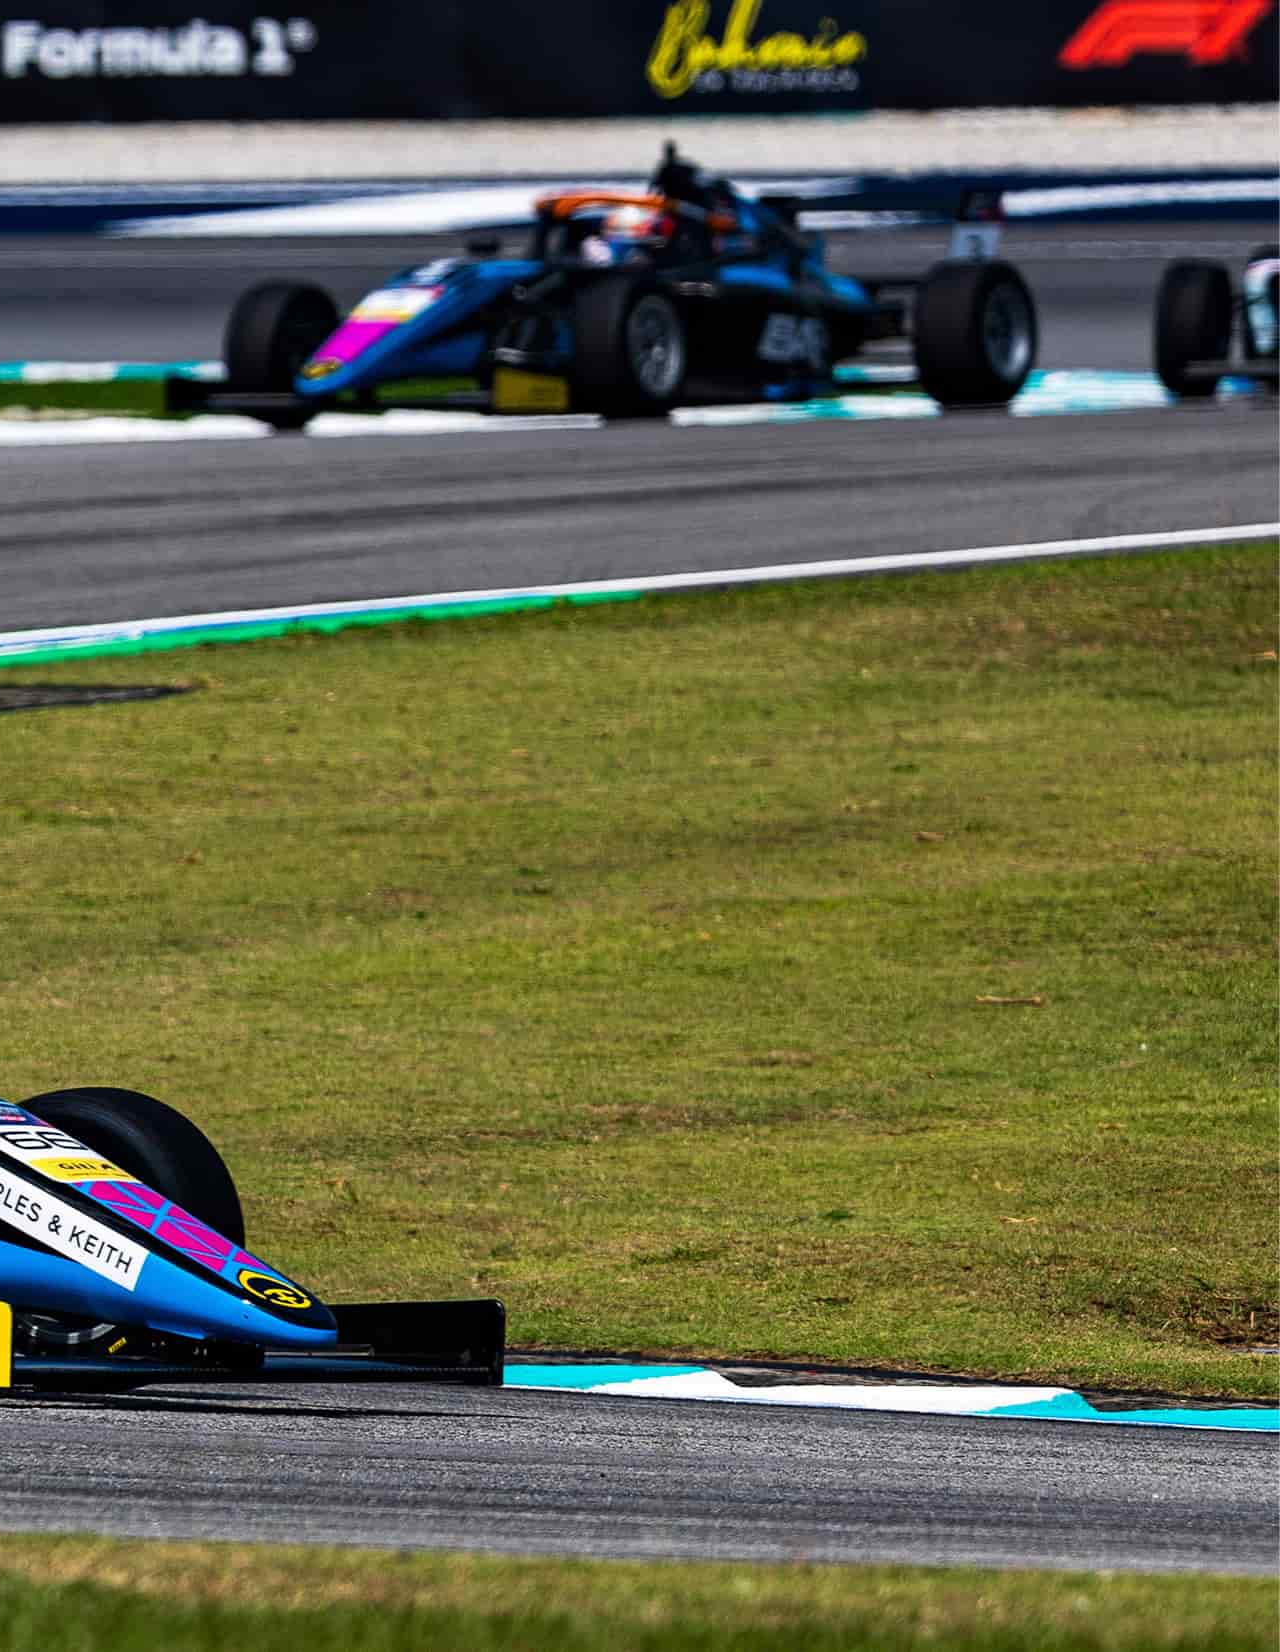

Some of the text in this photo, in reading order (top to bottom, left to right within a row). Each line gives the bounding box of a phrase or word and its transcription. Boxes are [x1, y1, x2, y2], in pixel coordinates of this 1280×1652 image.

[2, 20, 246, 78] Formula
[47, 1215, 62, 1236] &
[68, 1225, 133, 1274] KEITH
